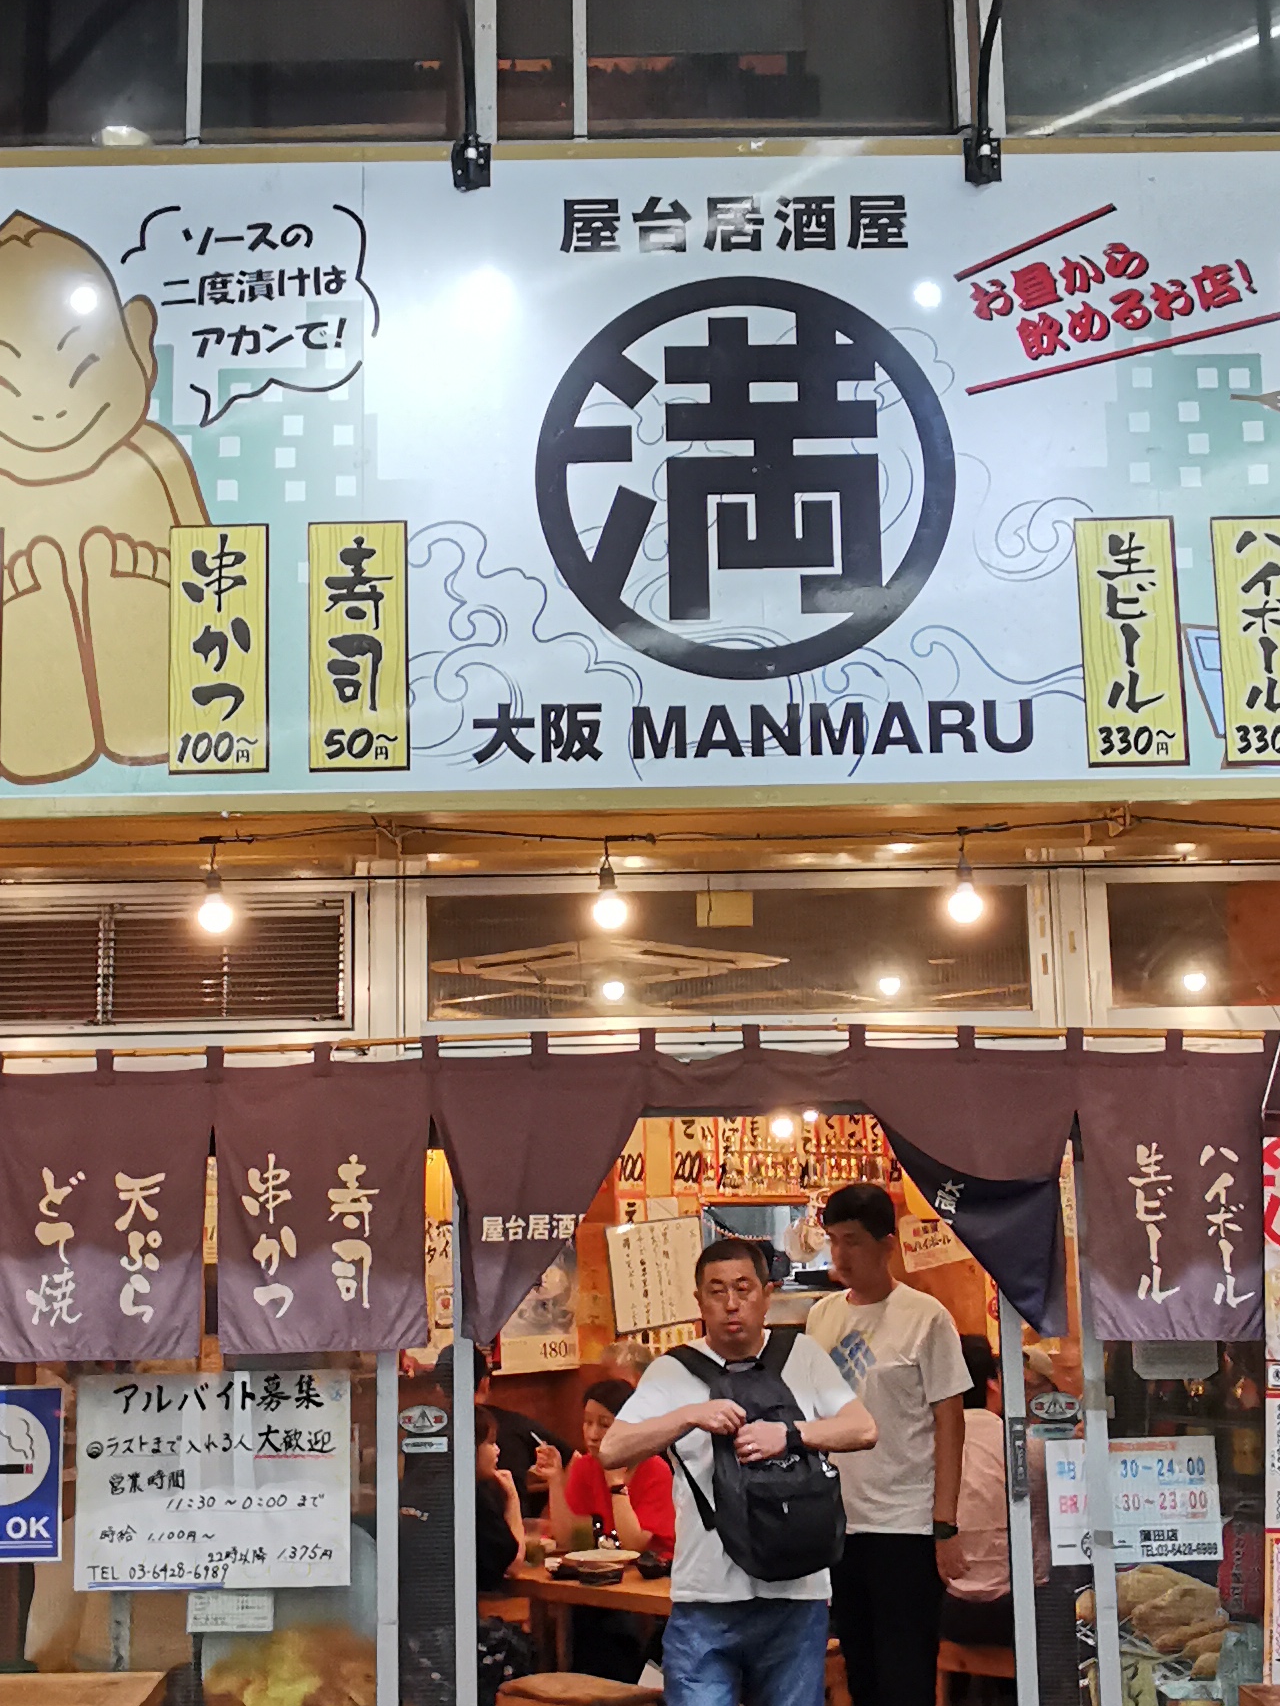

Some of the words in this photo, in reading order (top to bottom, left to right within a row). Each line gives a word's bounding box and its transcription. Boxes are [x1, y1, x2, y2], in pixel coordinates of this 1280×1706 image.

[182, 224, 314, 256] ソースの
[560, 194, 909, 254] 屋台居酒屋
[970, 242, 1148, 322] お昼から
[162, 268, 347, 308] 二度漬けは
[190, 318, 347, 359] アカンで!
[1016, 259, 1257, 359] 飲めるお店!
[535, 276, 956, 680] 満
[182, 535, 250, 723] 串かつ
[323, 535, 392, 712] 寿司
[1095, 533, 1164, 713] 生ビール
[473, 704, 602, 763] 大阪
[632, 699, 1035, 759] MANMARU
[26, 1166, 86, 1326] どて焼
[116, 1173, 165, 1324] 天ぷら
[241, 1152, 297, 1318] 串かつ
[327, 1154, 380, 1309] 寿司
[1128, 1143, 1180, 1303] 生ビール
[1200, 1145, 1255, 1306] ハイボール
[113, 1373, 325, 1414] アルバイト募集
[6, 1516, 51, 1539] OK
[87, 1565, 120, 1581] TEL
